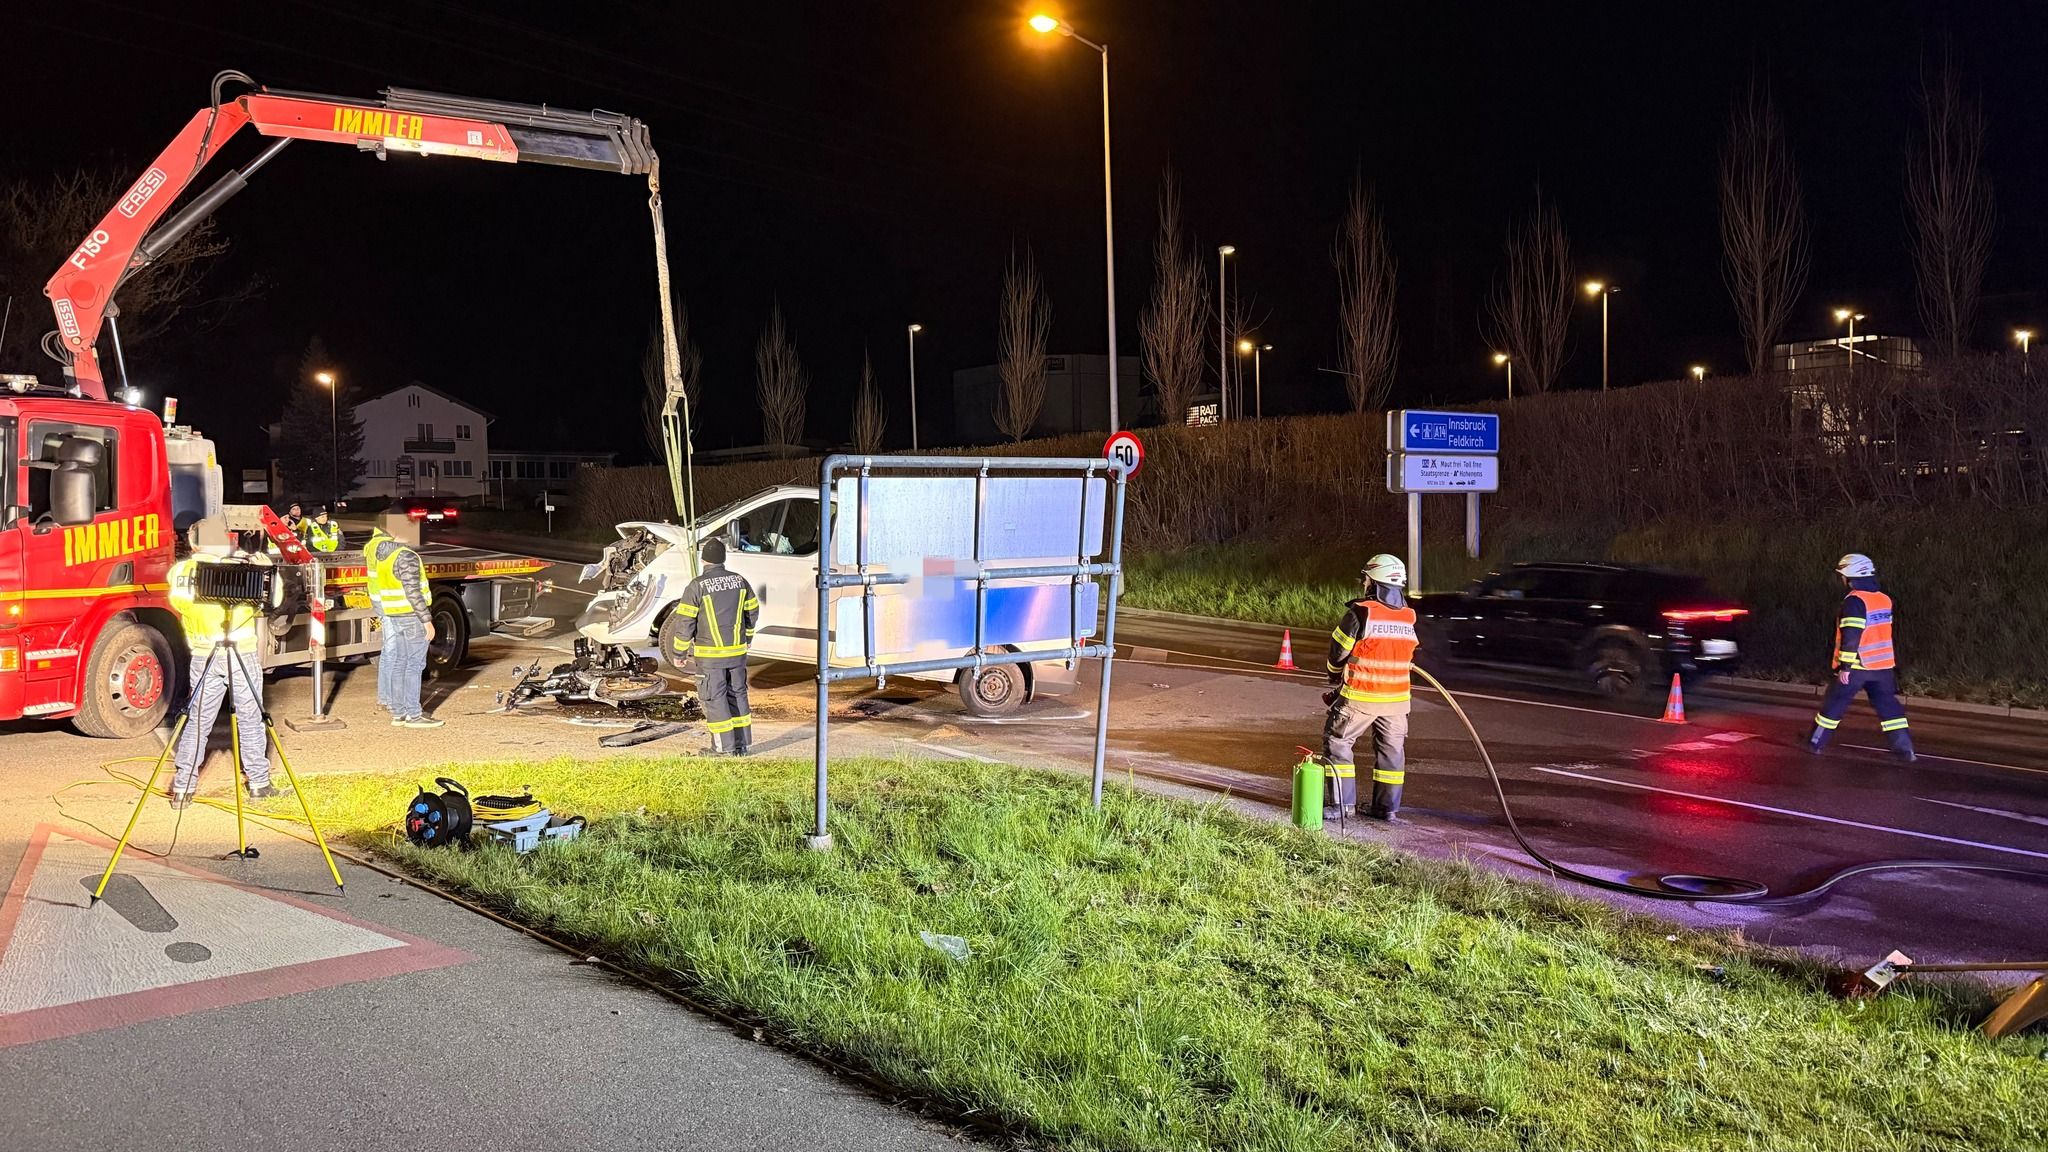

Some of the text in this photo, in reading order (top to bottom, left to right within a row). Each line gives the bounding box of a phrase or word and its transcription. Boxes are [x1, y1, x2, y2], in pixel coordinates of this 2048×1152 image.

[333, 107, 424, 140] IMMLER
[121, 171, 165, 215] FASSI
[70, 229, 110, 270] F150
[58, 302, 77, 334] FASSI
[1200, 415, 1218, 424] PACK
[1449, 418, 1487, 431] Innsbruck
[1434, 425, 1447, 438] A14
[1449, 435, 1484, 447] Feldkirch
[1116, 446, 1133, 467] 50
[1420, 469, 1450, 478] Staatsgrenze
[64, 513, 159, 567] IMMLER
[699, 574, 744, 588] FEUERWEHR
[706, 581, 742, 593] WOLFURT
